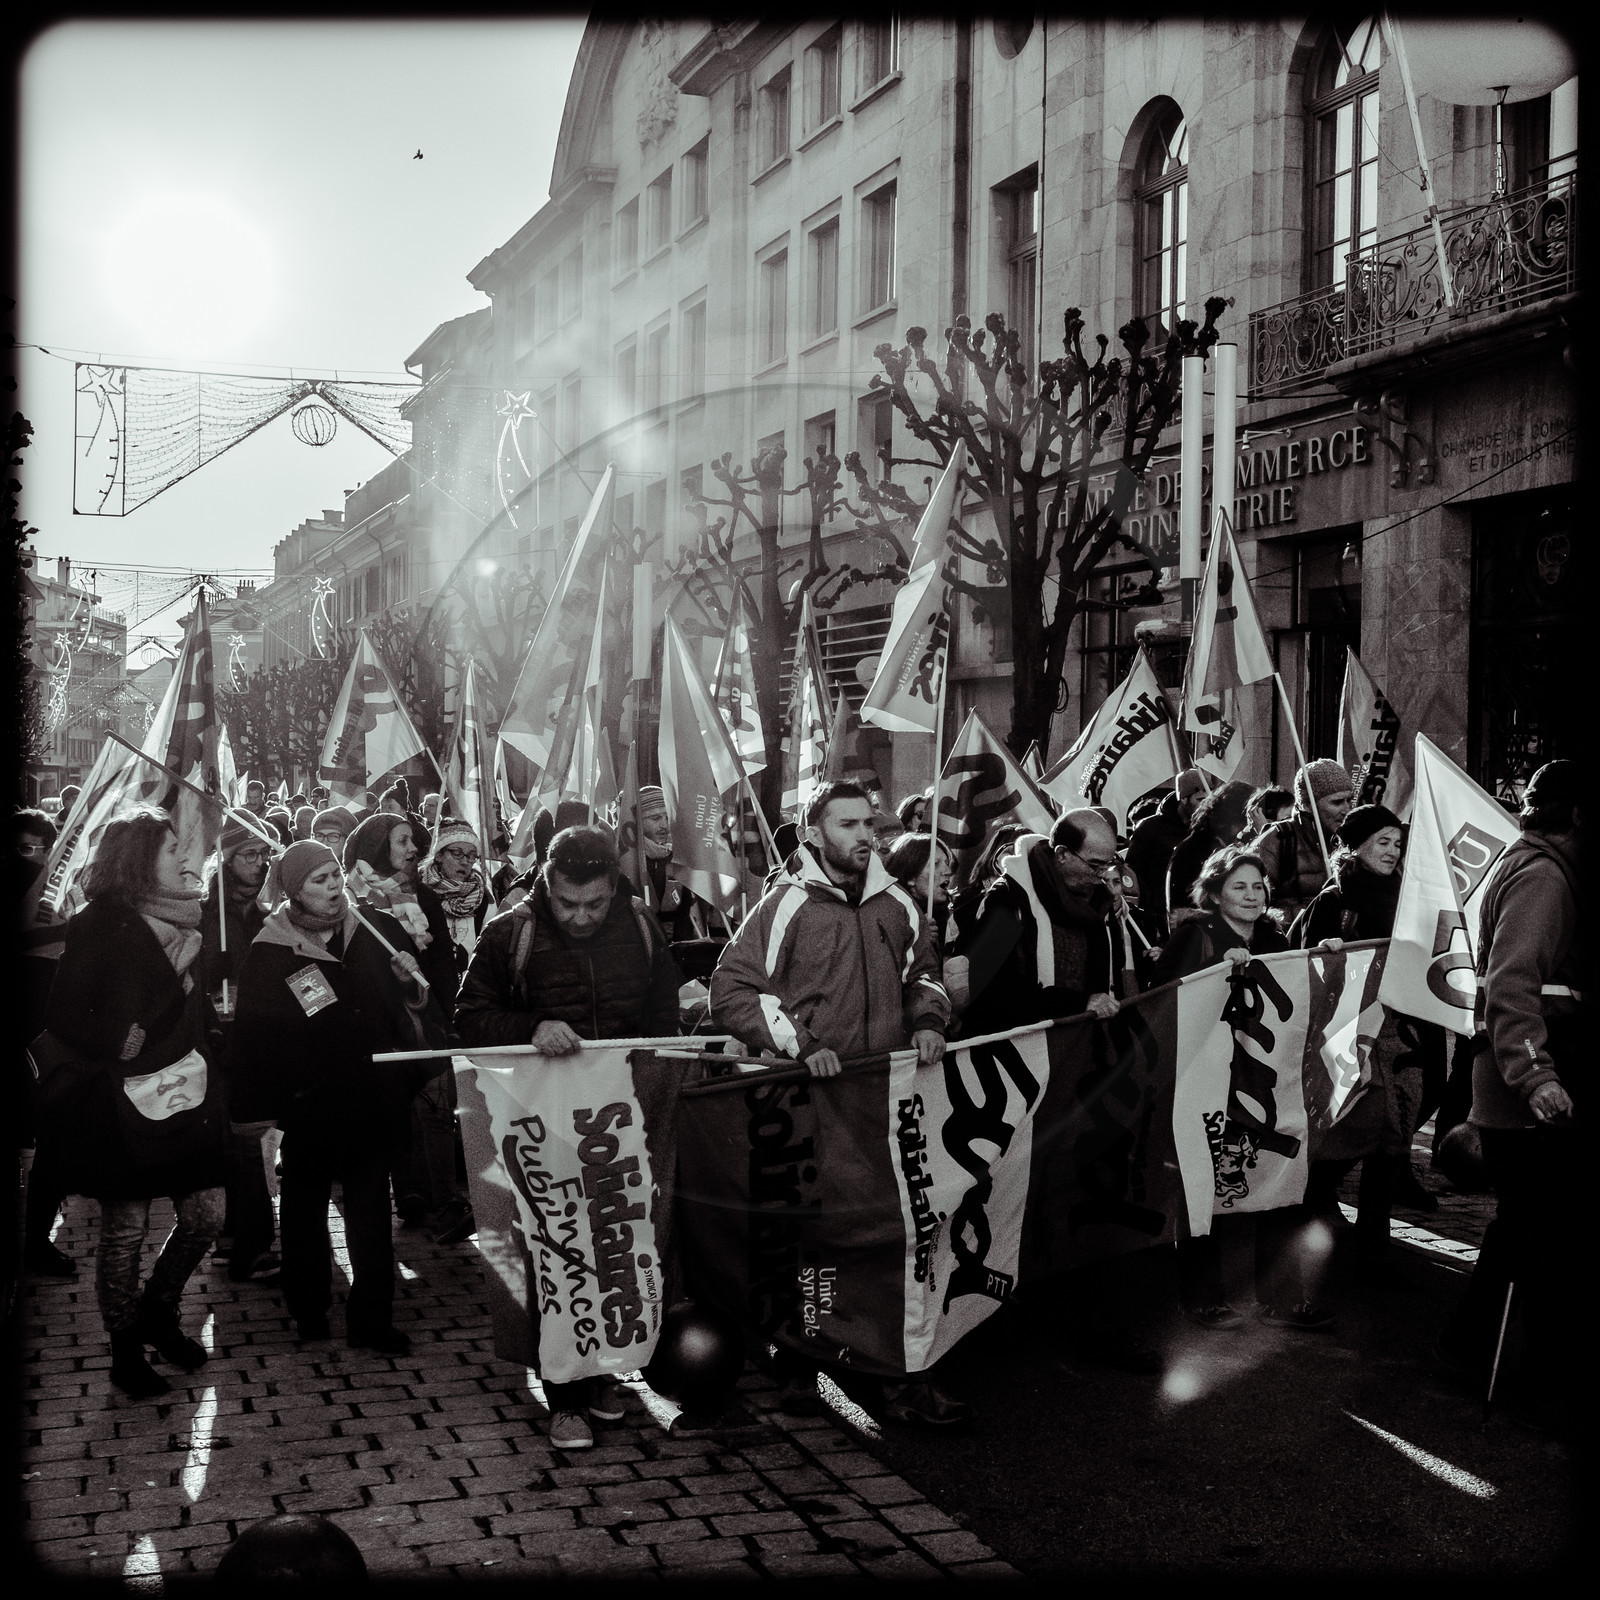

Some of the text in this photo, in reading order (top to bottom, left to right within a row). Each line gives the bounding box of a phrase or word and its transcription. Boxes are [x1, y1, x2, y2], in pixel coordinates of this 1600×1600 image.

[1201, 426, 1368, 498] CMMERCE
[1470, 455, 1486, 472] ET
[510, 1114, 562, 1315] Publiques
[573, 1102, 653, 1348] Solidaires
[550, 1176, 601, 1357] Finances
[644, 1269, 658, 1300] SYNDICAT
[986, 1273, 1009, 1298] PTT
